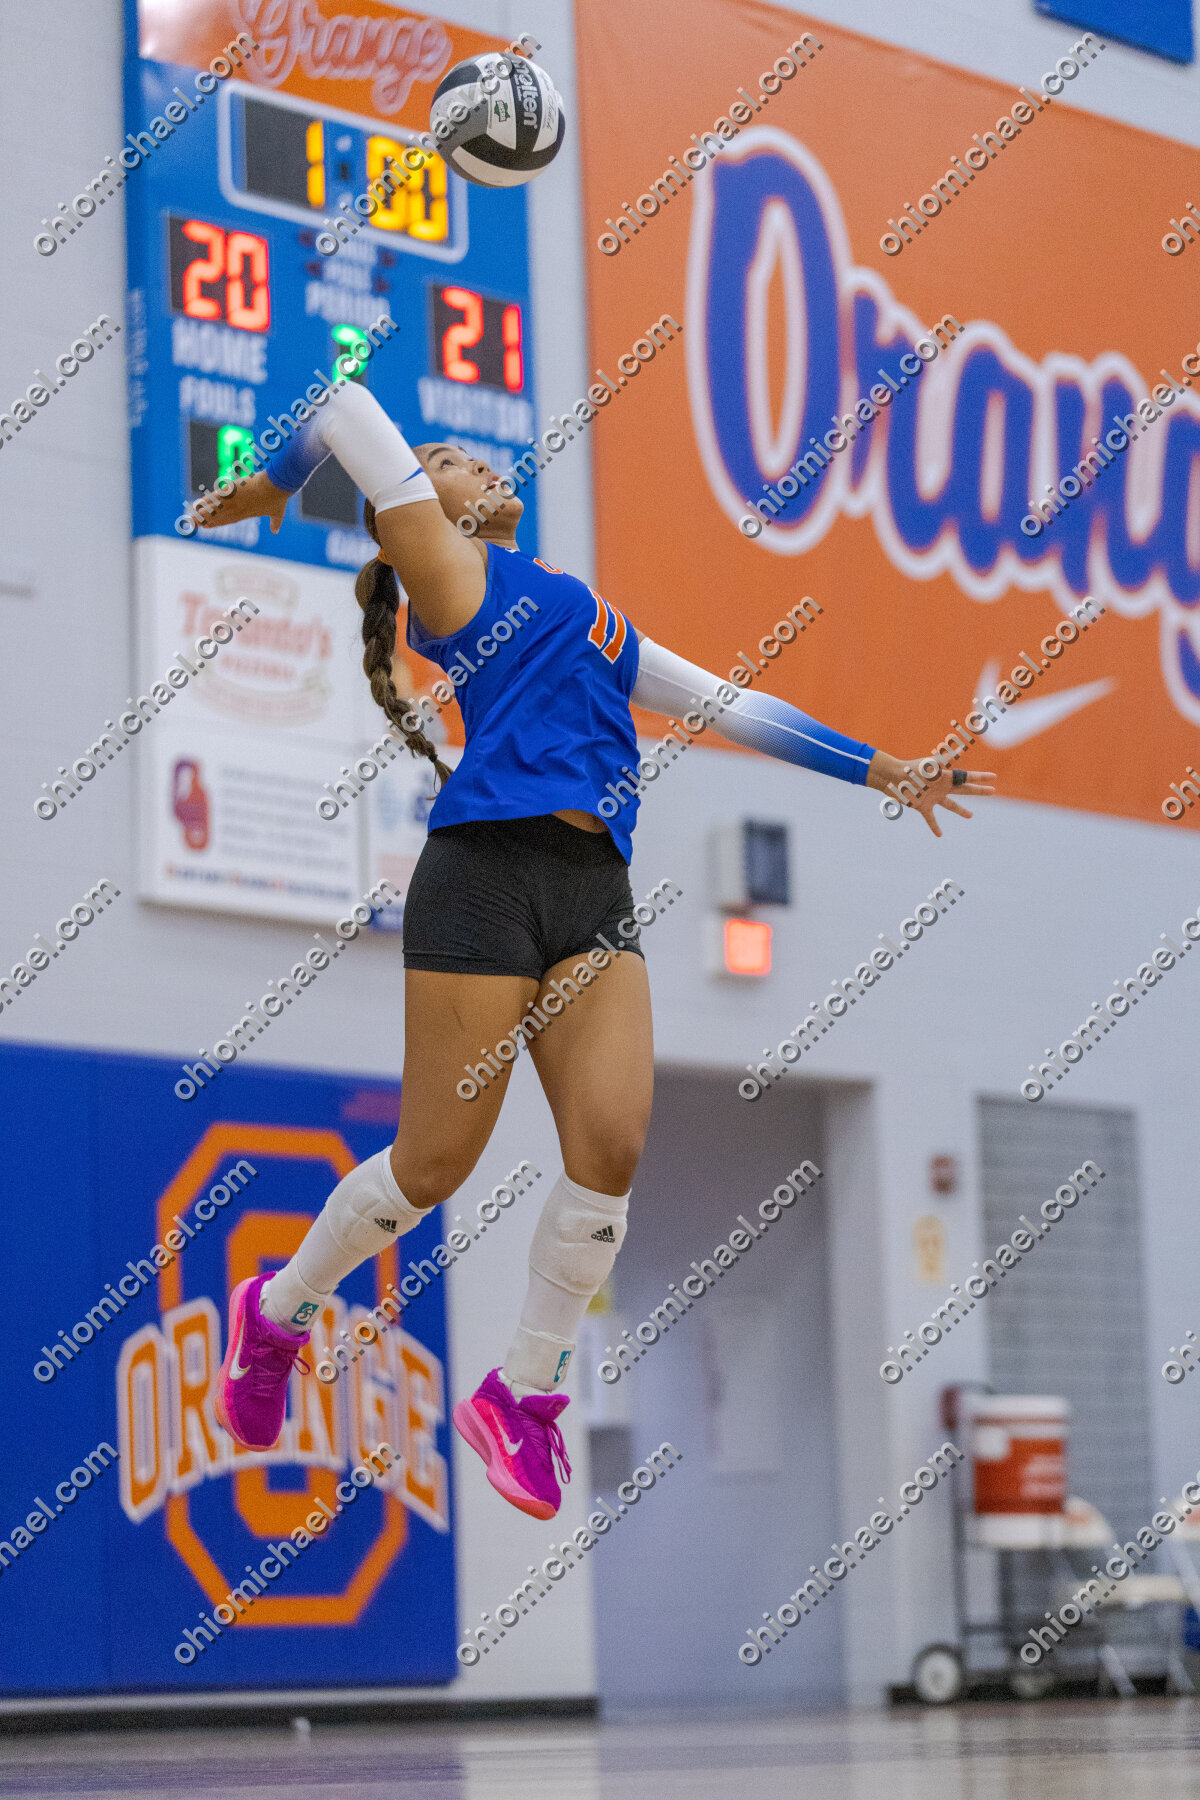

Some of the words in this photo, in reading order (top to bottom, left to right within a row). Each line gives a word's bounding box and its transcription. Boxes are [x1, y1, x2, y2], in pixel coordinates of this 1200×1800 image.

[183, 219, 270, 332] 20
[441, 286, 524, 393] 21
[590, 1232, 616, 1244] adidas
[116, 1296, 448, 1534] ORNGE
